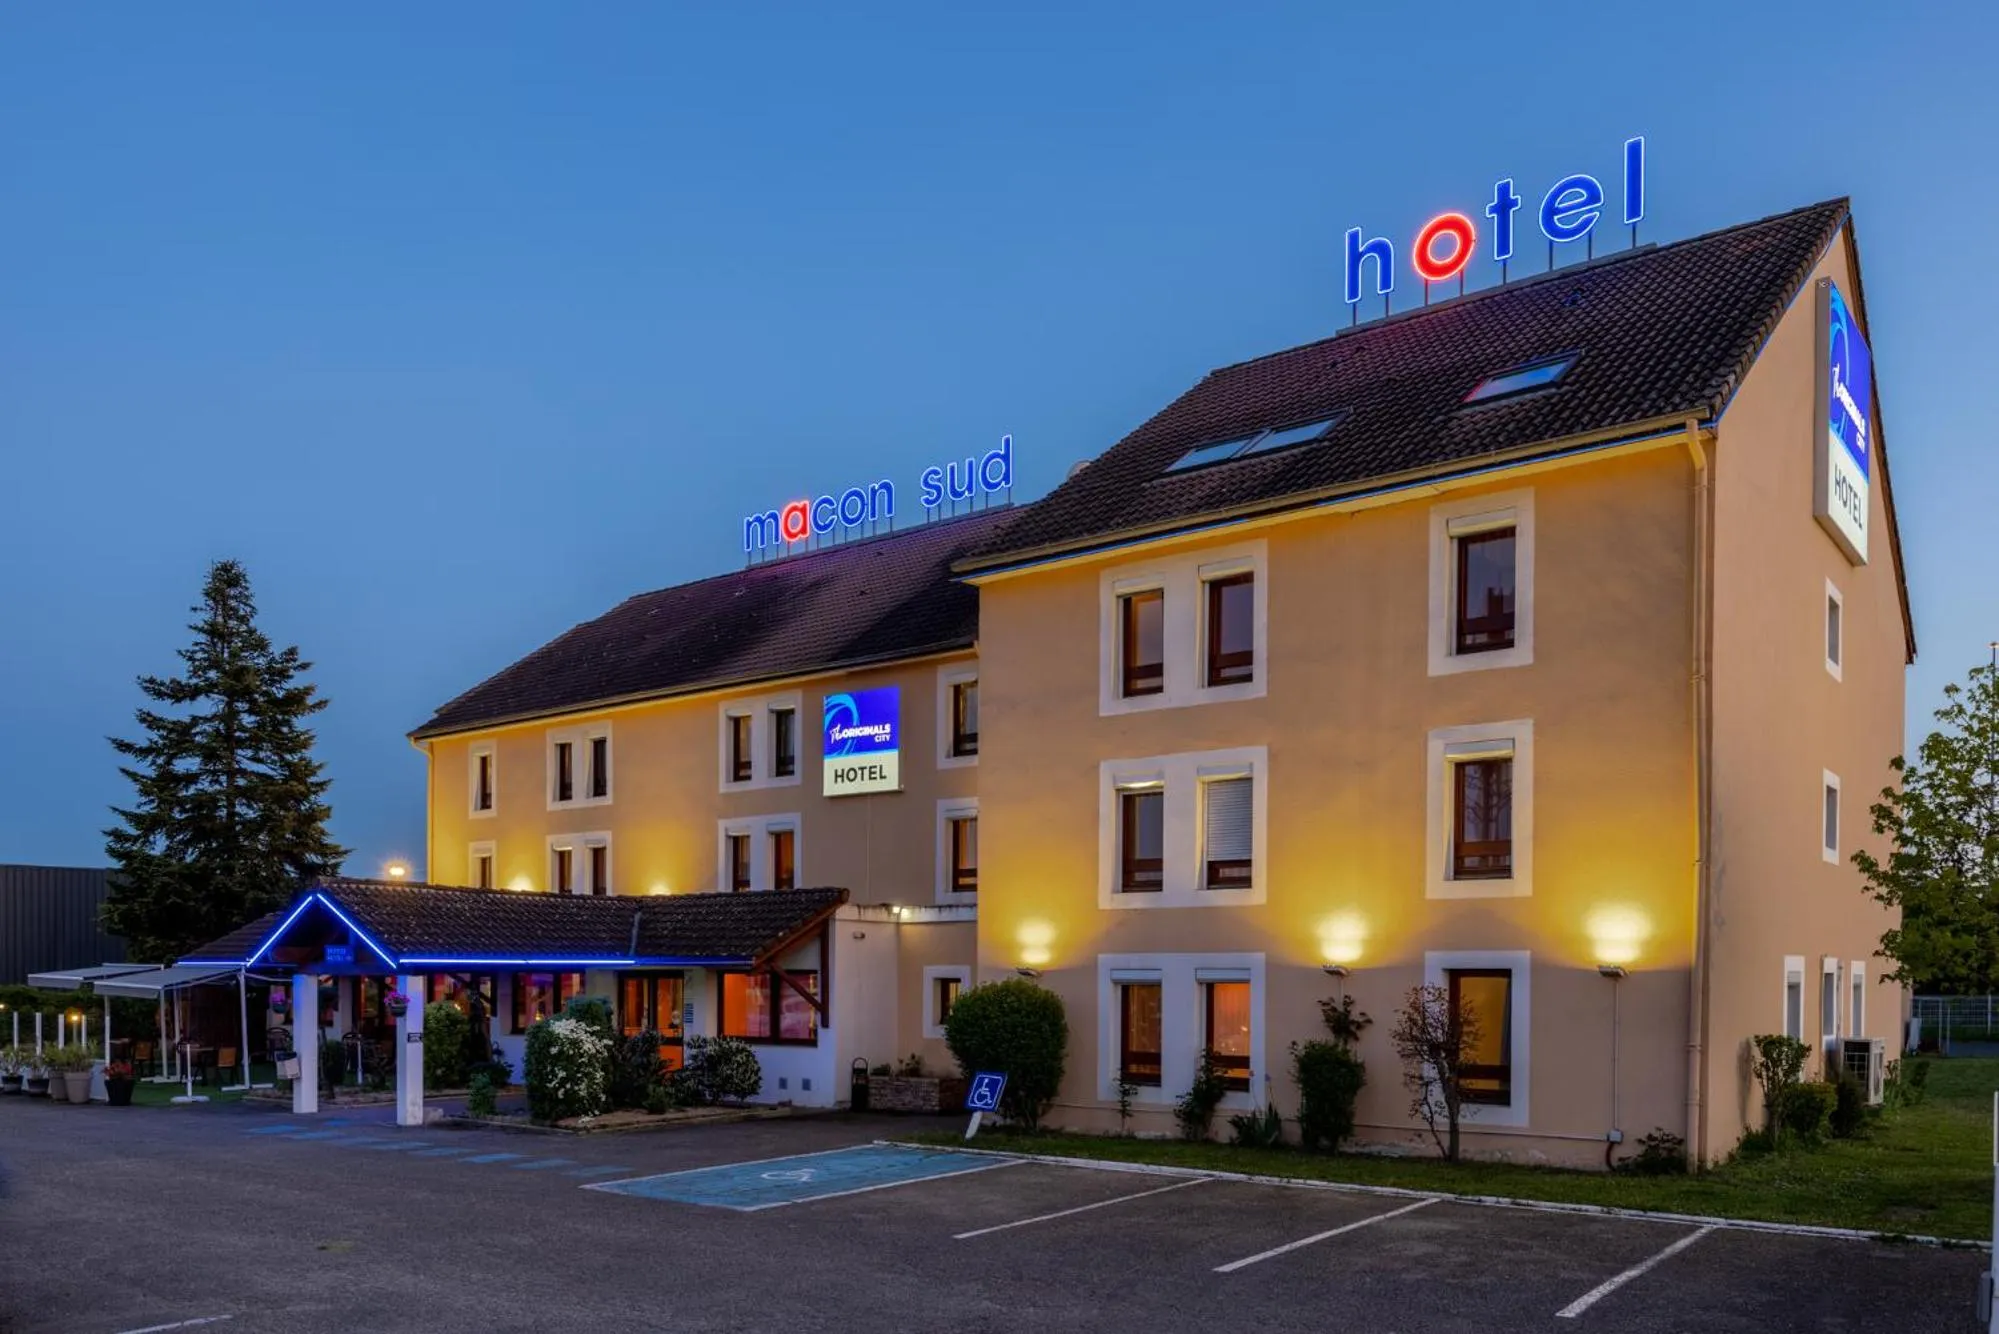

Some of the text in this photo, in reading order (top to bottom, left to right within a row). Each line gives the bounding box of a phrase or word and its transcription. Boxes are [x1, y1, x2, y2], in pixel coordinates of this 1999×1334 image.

[1344, 135, 1645, 304] hotel
[743, 434, 1012, 551] macon sud
[1834, 463, 1863, 531] HOTEL
[833, 763, 887, 784] HOTEL
